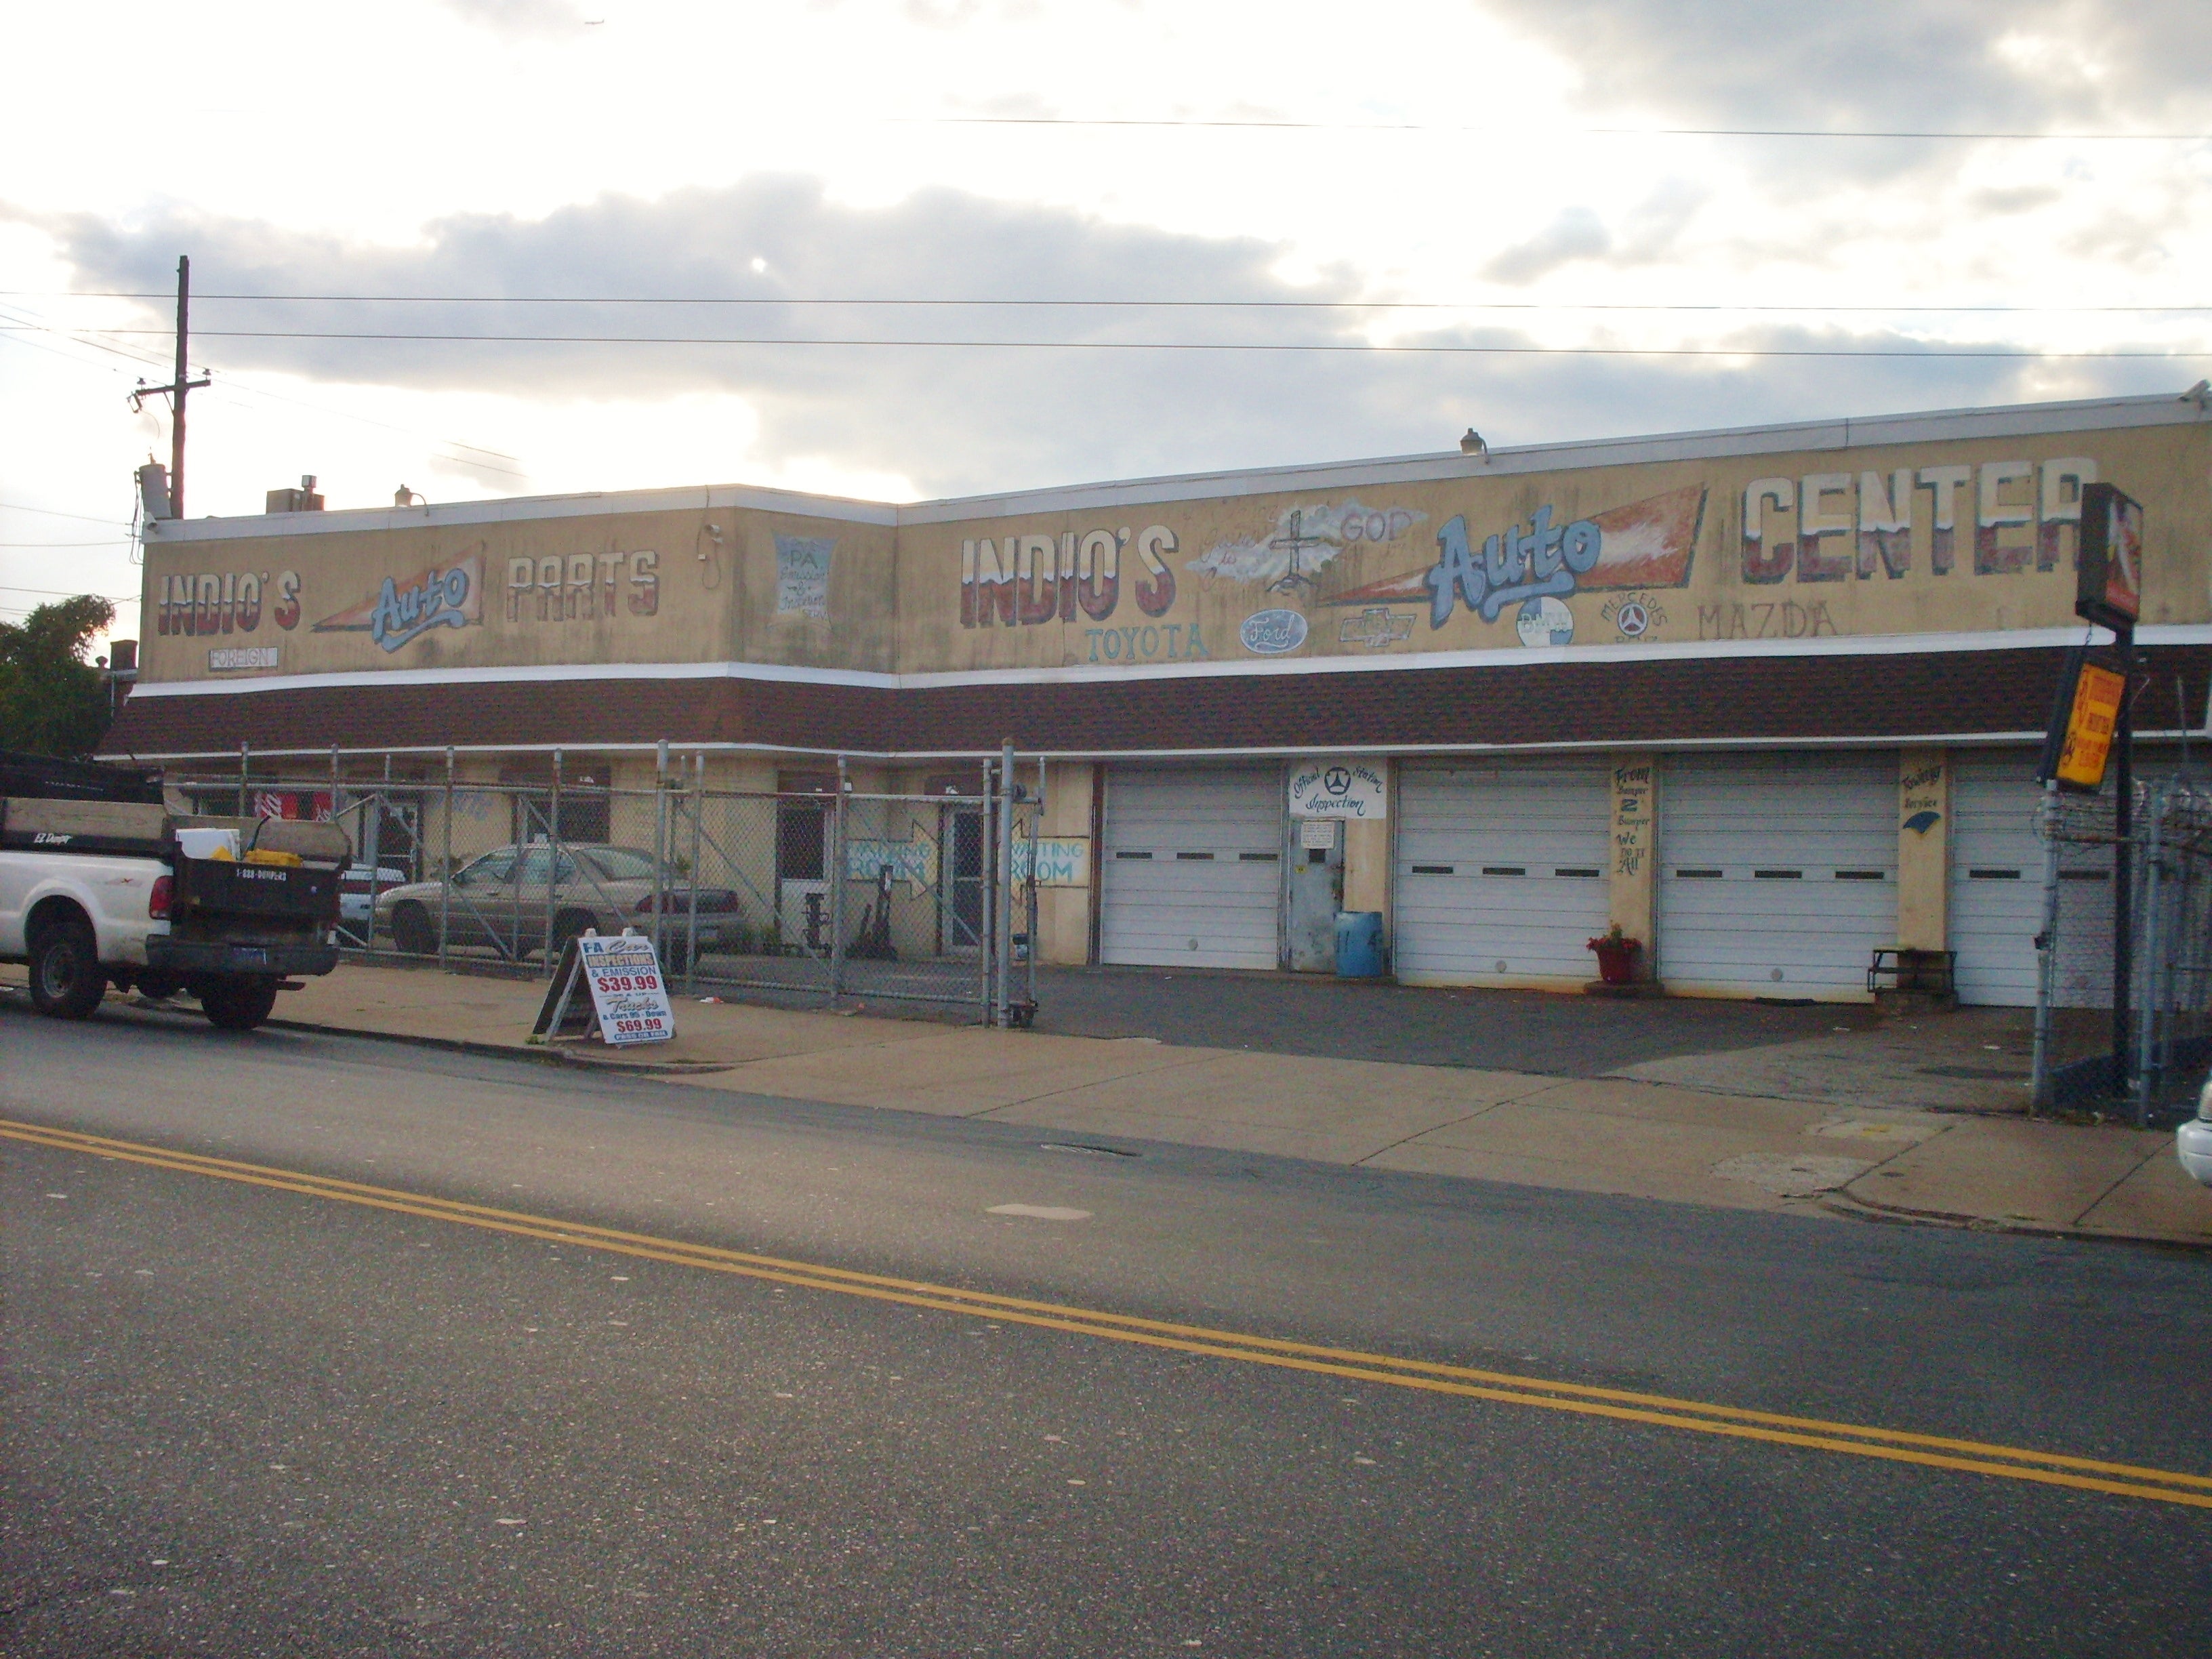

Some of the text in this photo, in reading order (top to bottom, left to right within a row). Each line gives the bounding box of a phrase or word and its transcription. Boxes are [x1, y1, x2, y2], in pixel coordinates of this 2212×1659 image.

[1740, 457, 2097, 585] CENTER
[790, 550, 818, 569] PA
[1429, 504, 1601, 630] Auto
[960, 525, 1179, 628] INDIO'S
[157, 550, 659, 652] INDIO'S Auto PARTS
[1600, 592, 1668, 627] MERCEDES
[1249, 613, 1296, 649] Ford
[1698, 600, 1837, 641] MAZDA
[211, 649, 268, 665] FOREIGN
[1084, 623, 1209, 662] TOYOTA
[1294, 766, 1383, 799] Official Station
[1306, 793, 1366, 817] Inspection
[1011, 842, 1084, 858] WATING
[588, 953, 654, 967] INSPECTIONS
[592, 966, 657, 978] & EMISSION
[597, 975, 658, 994] $39.99
[616, 1018, 662, 1033] $69.99
